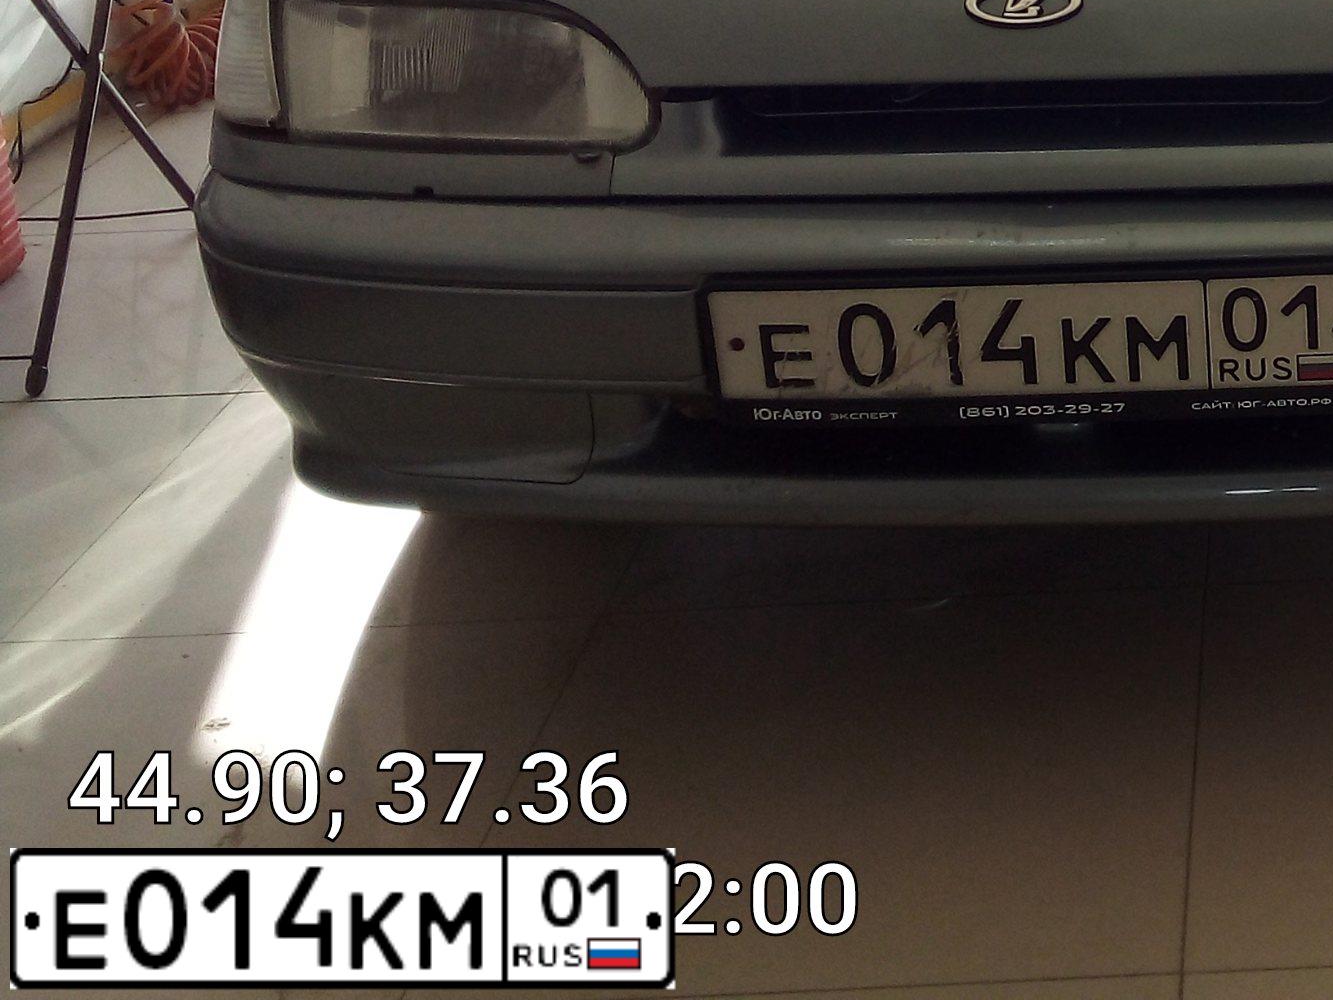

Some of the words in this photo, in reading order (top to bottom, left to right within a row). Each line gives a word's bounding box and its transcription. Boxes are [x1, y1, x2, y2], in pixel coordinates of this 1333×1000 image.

[1222, 285, 1320, 351] 01
[758, 297, 1190, 389] Е014КМ
[1219, 356, 1292, 384] RUS
[1015, 402, 1126, 417] 203-29-27
